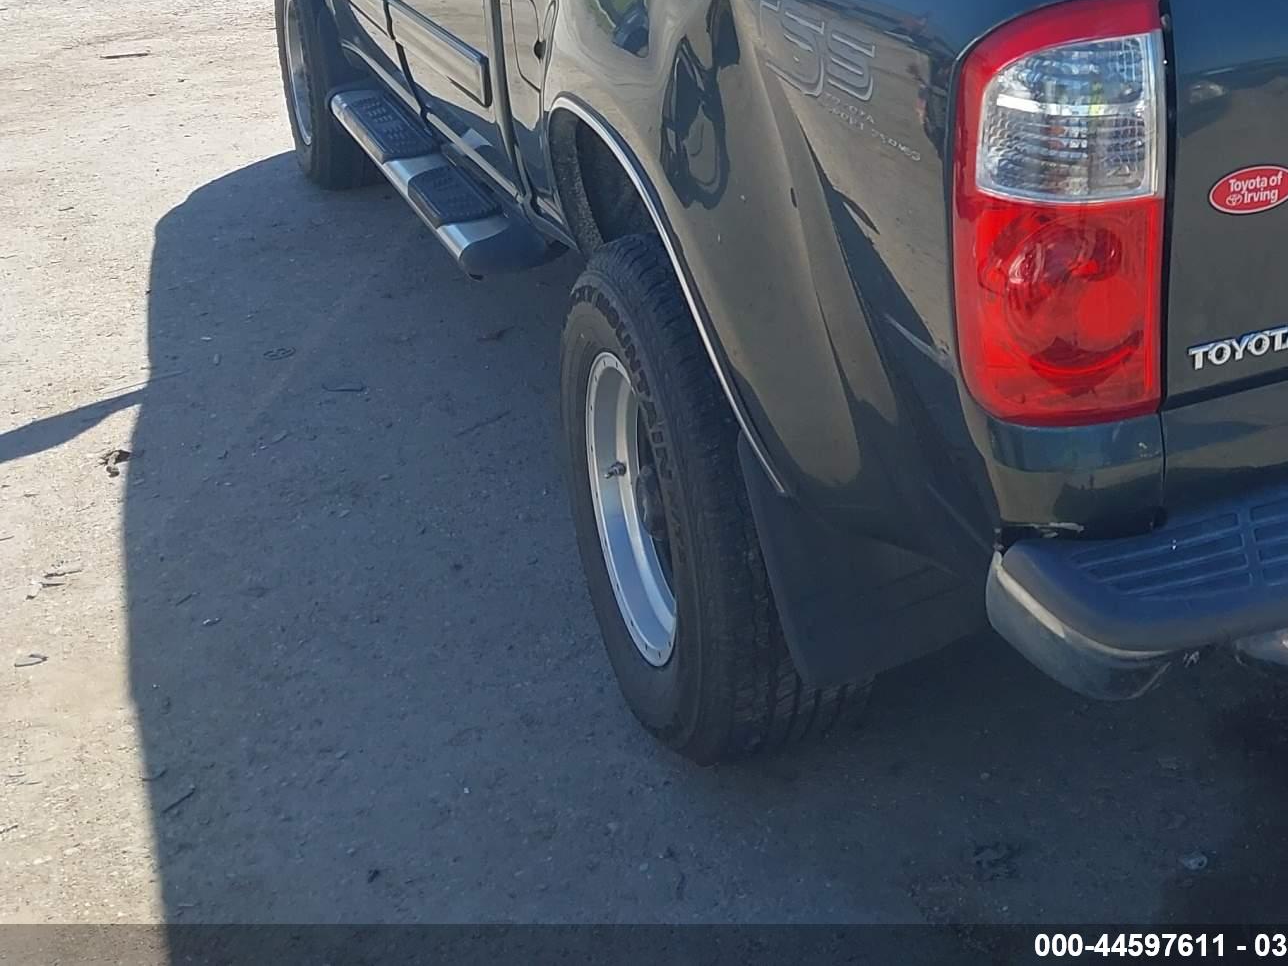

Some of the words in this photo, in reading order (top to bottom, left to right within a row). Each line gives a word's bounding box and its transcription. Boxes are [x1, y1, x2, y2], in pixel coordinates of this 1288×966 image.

[1228, 175, 1268, 195] Toyota
[1269, 170, 1283, 186] of
[1243, 188, 1279, 204] Irving
